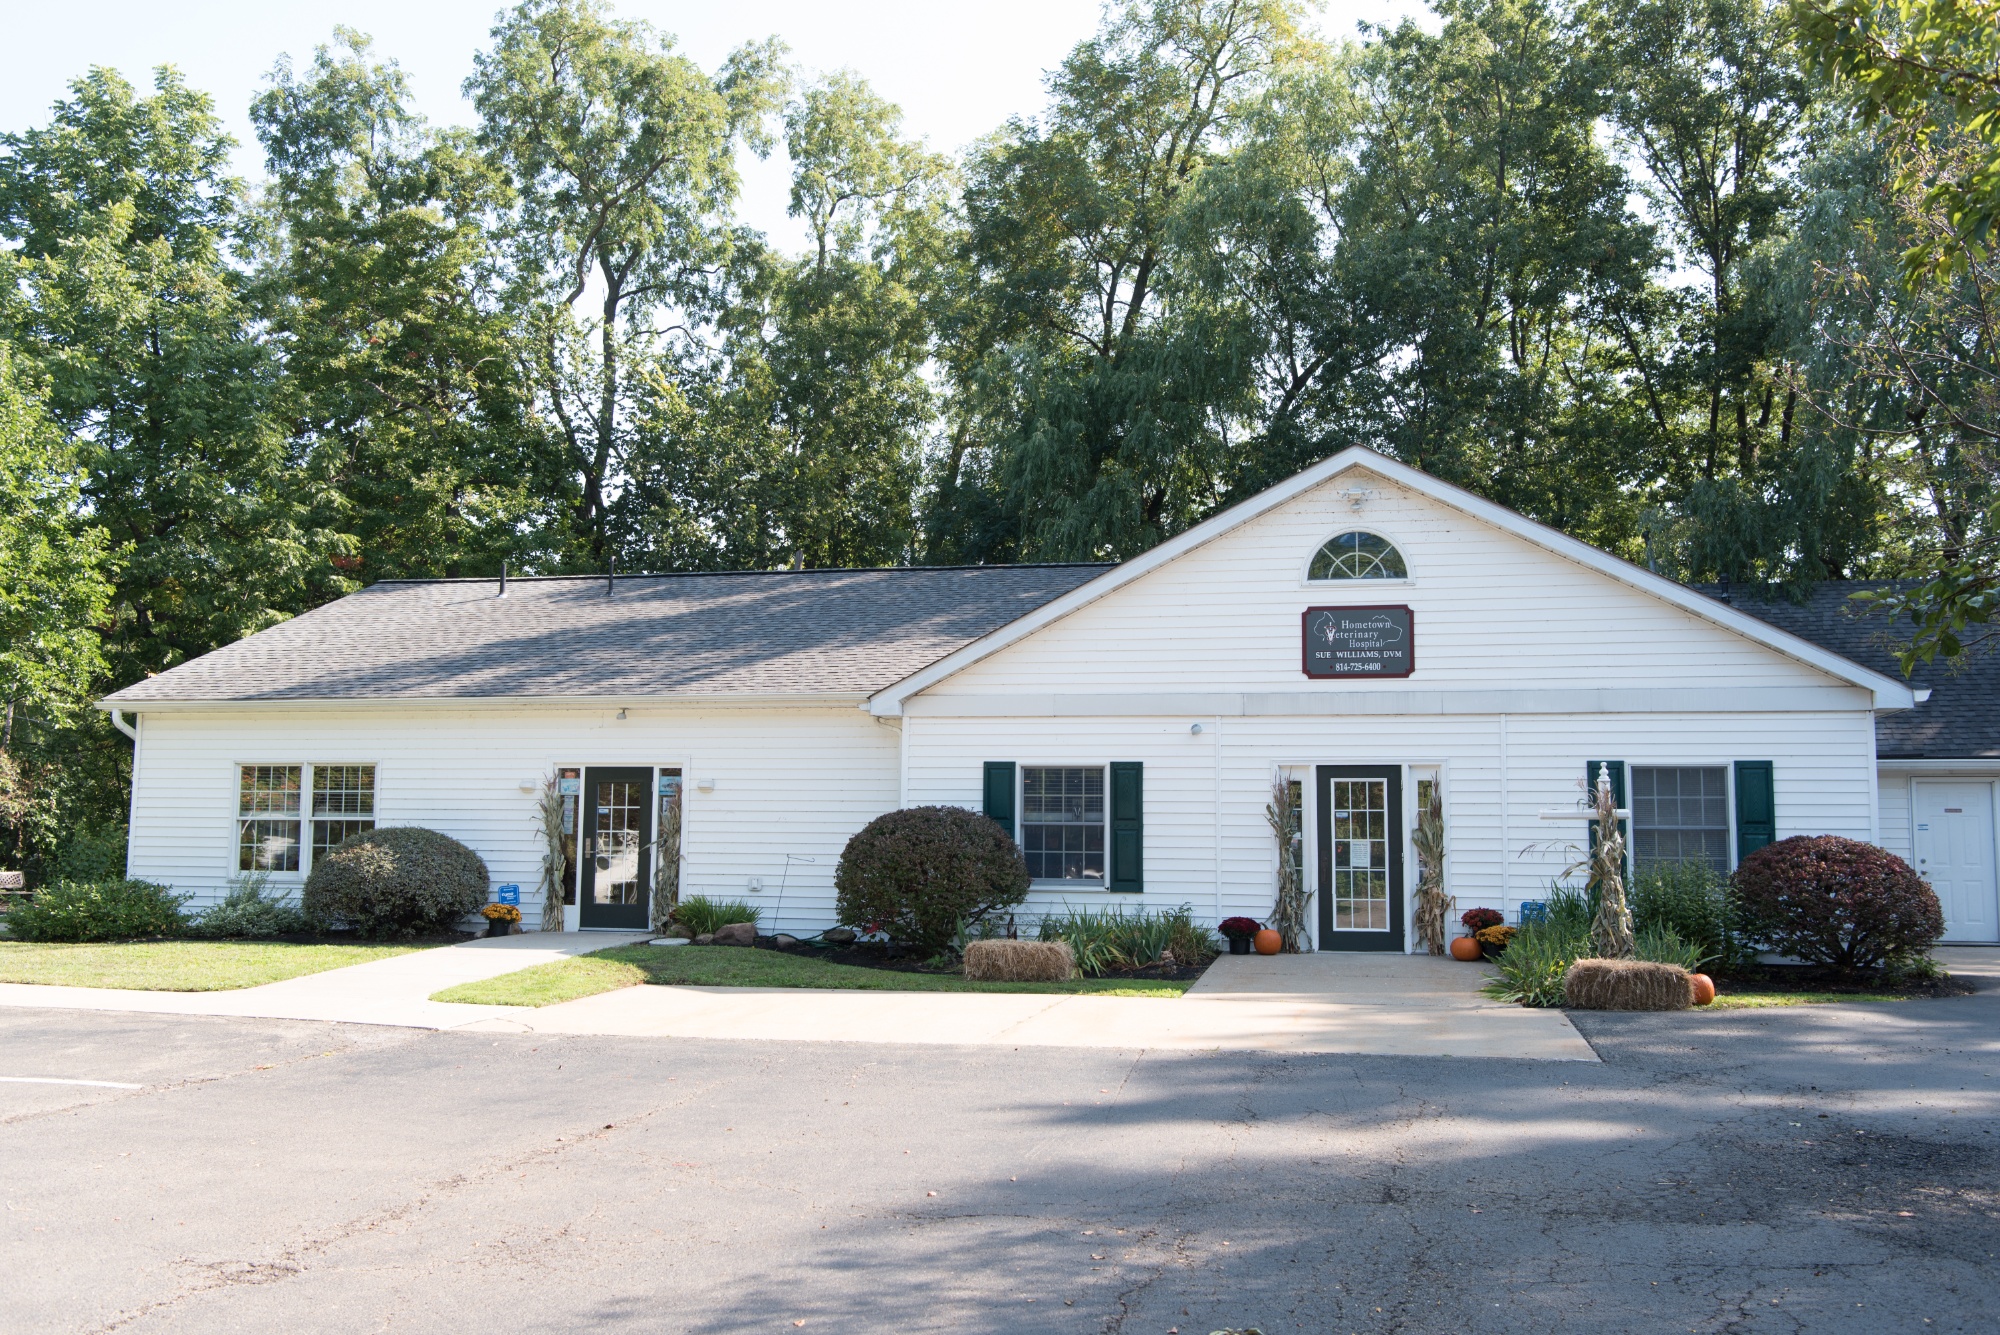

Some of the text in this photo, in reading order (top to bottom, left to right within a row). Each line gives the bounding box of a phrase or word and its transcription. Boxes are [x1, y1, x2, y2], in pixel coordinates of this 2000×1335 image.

[1341, 620, 1390, 629] Hometown
[1349, 640, 1383, 650] Hospital
[1335, 663, 1381, 671] 814-725-6400
